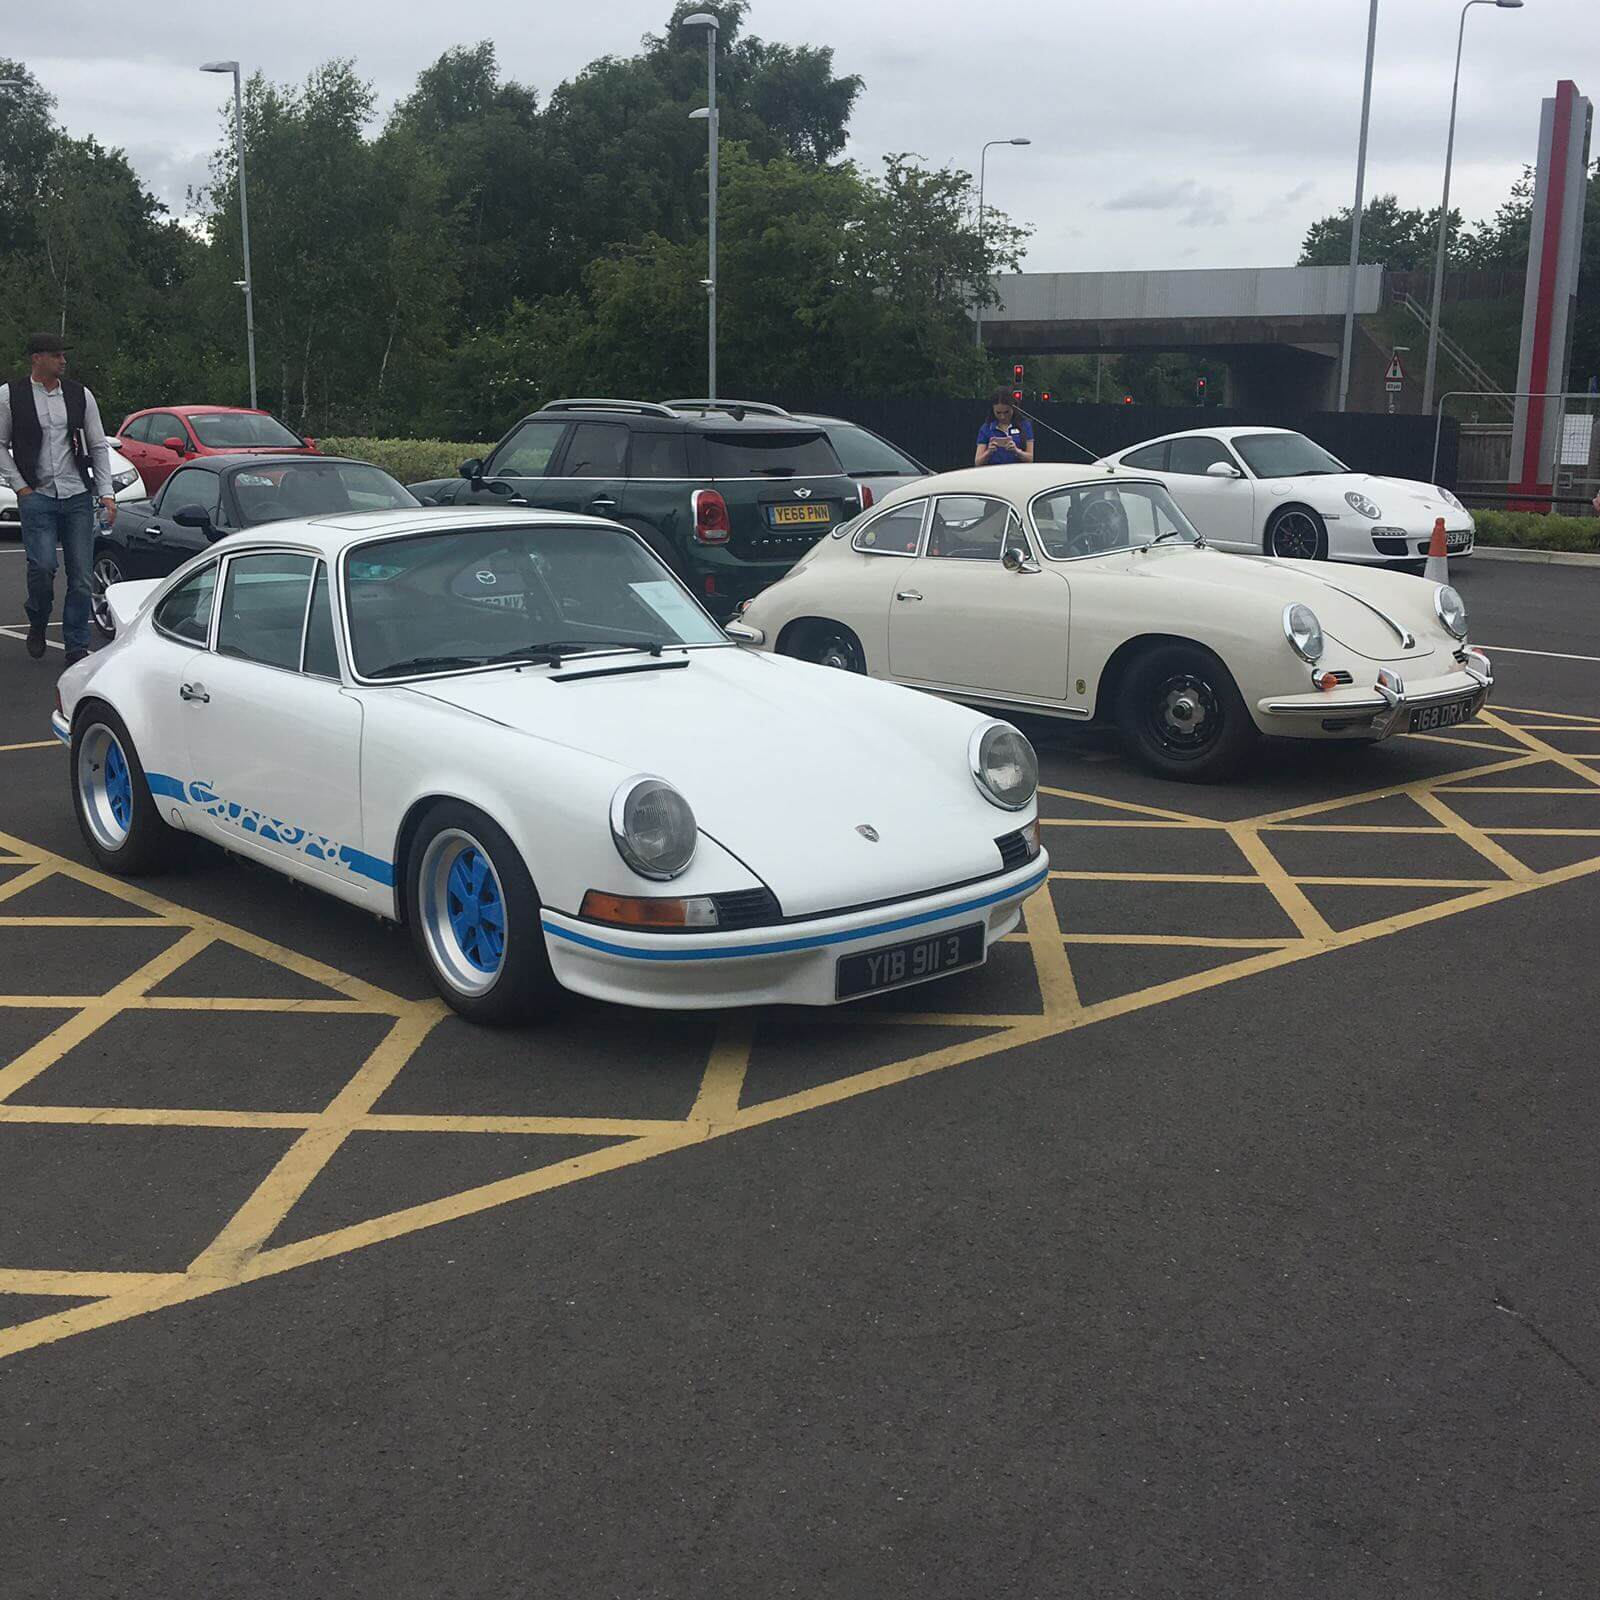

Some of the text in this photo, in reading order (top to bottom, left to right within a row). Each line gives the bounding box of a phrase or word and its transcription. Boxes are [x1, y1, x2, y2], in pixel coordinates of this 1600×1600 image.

[775, 504, 828, 521] YE66 PNN
[1417, 702, 1465, 731] 168 DRX
[183, 778, 353, 869] Carrera
[867, 936, 960, 985] YIB 911 3
